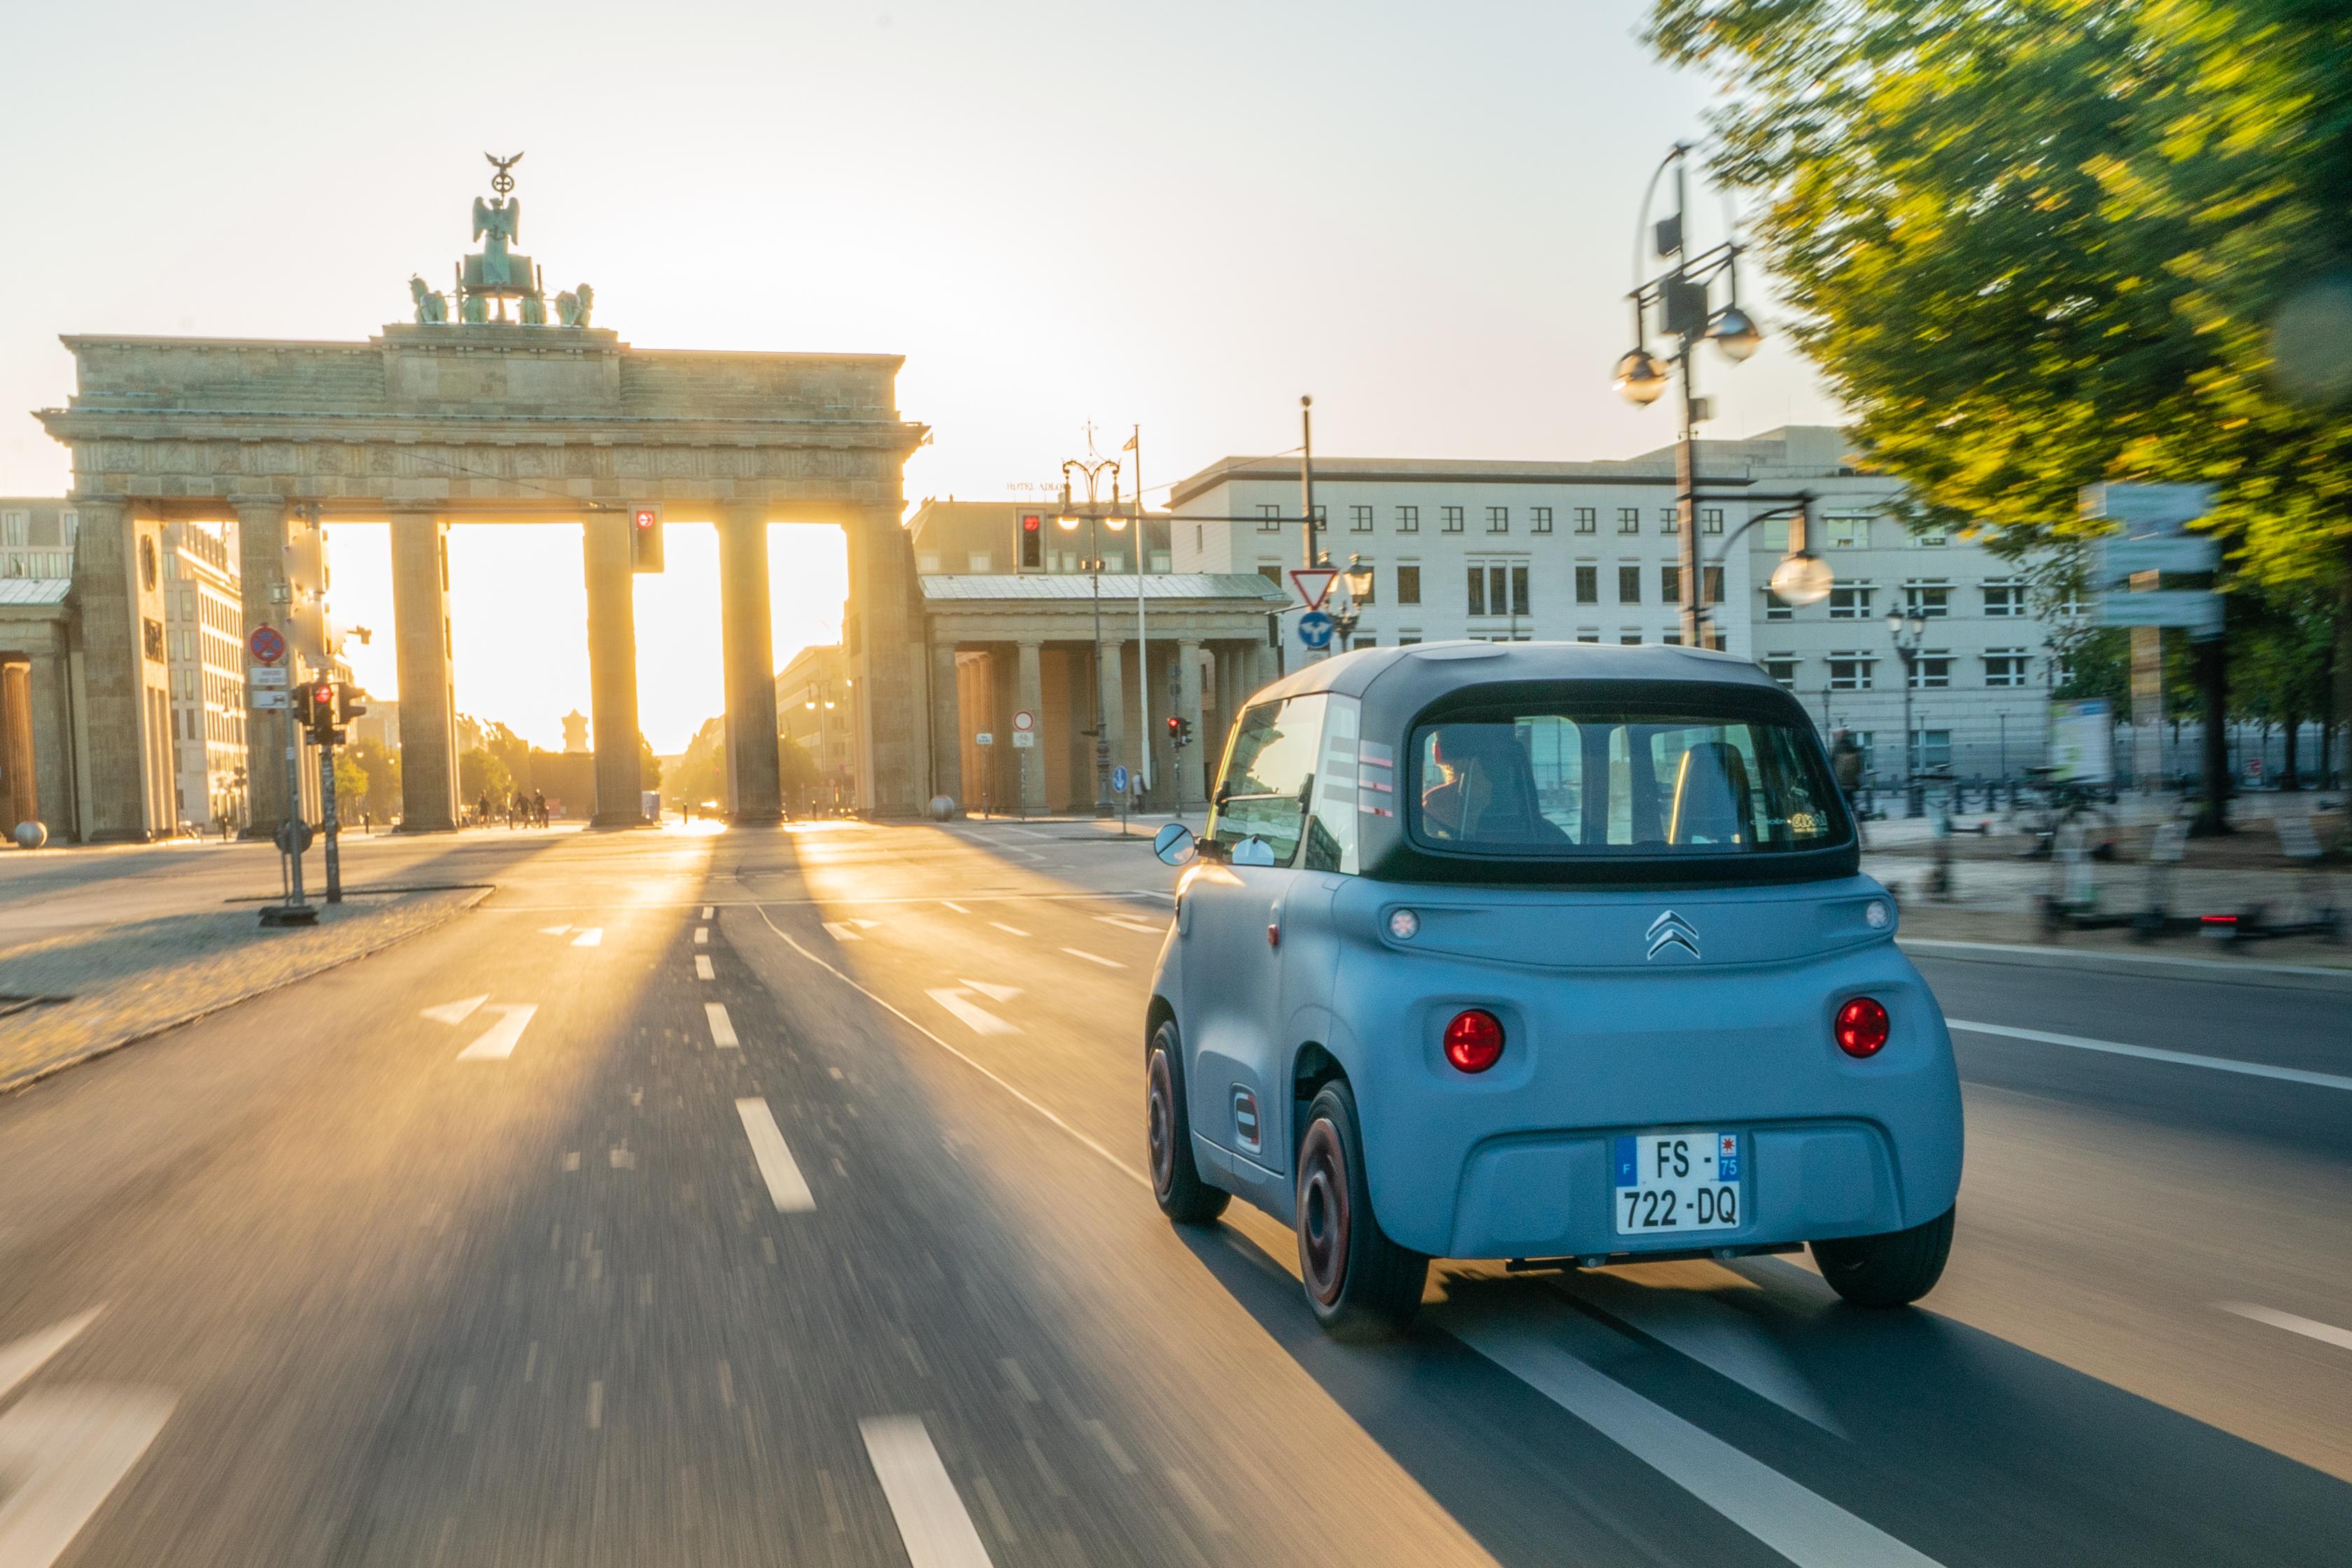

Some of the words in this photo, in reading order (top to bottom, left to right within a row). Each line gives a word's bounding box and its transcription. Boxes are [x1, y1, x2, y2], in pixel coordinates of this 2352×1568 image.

[1006, 482, 1034, 490] HOTEL
[1040, 482, 1064, 491] ADLO
[1623, 1164, 1631, 1175] F
[1721, 1159, 1737, 1175] 75
